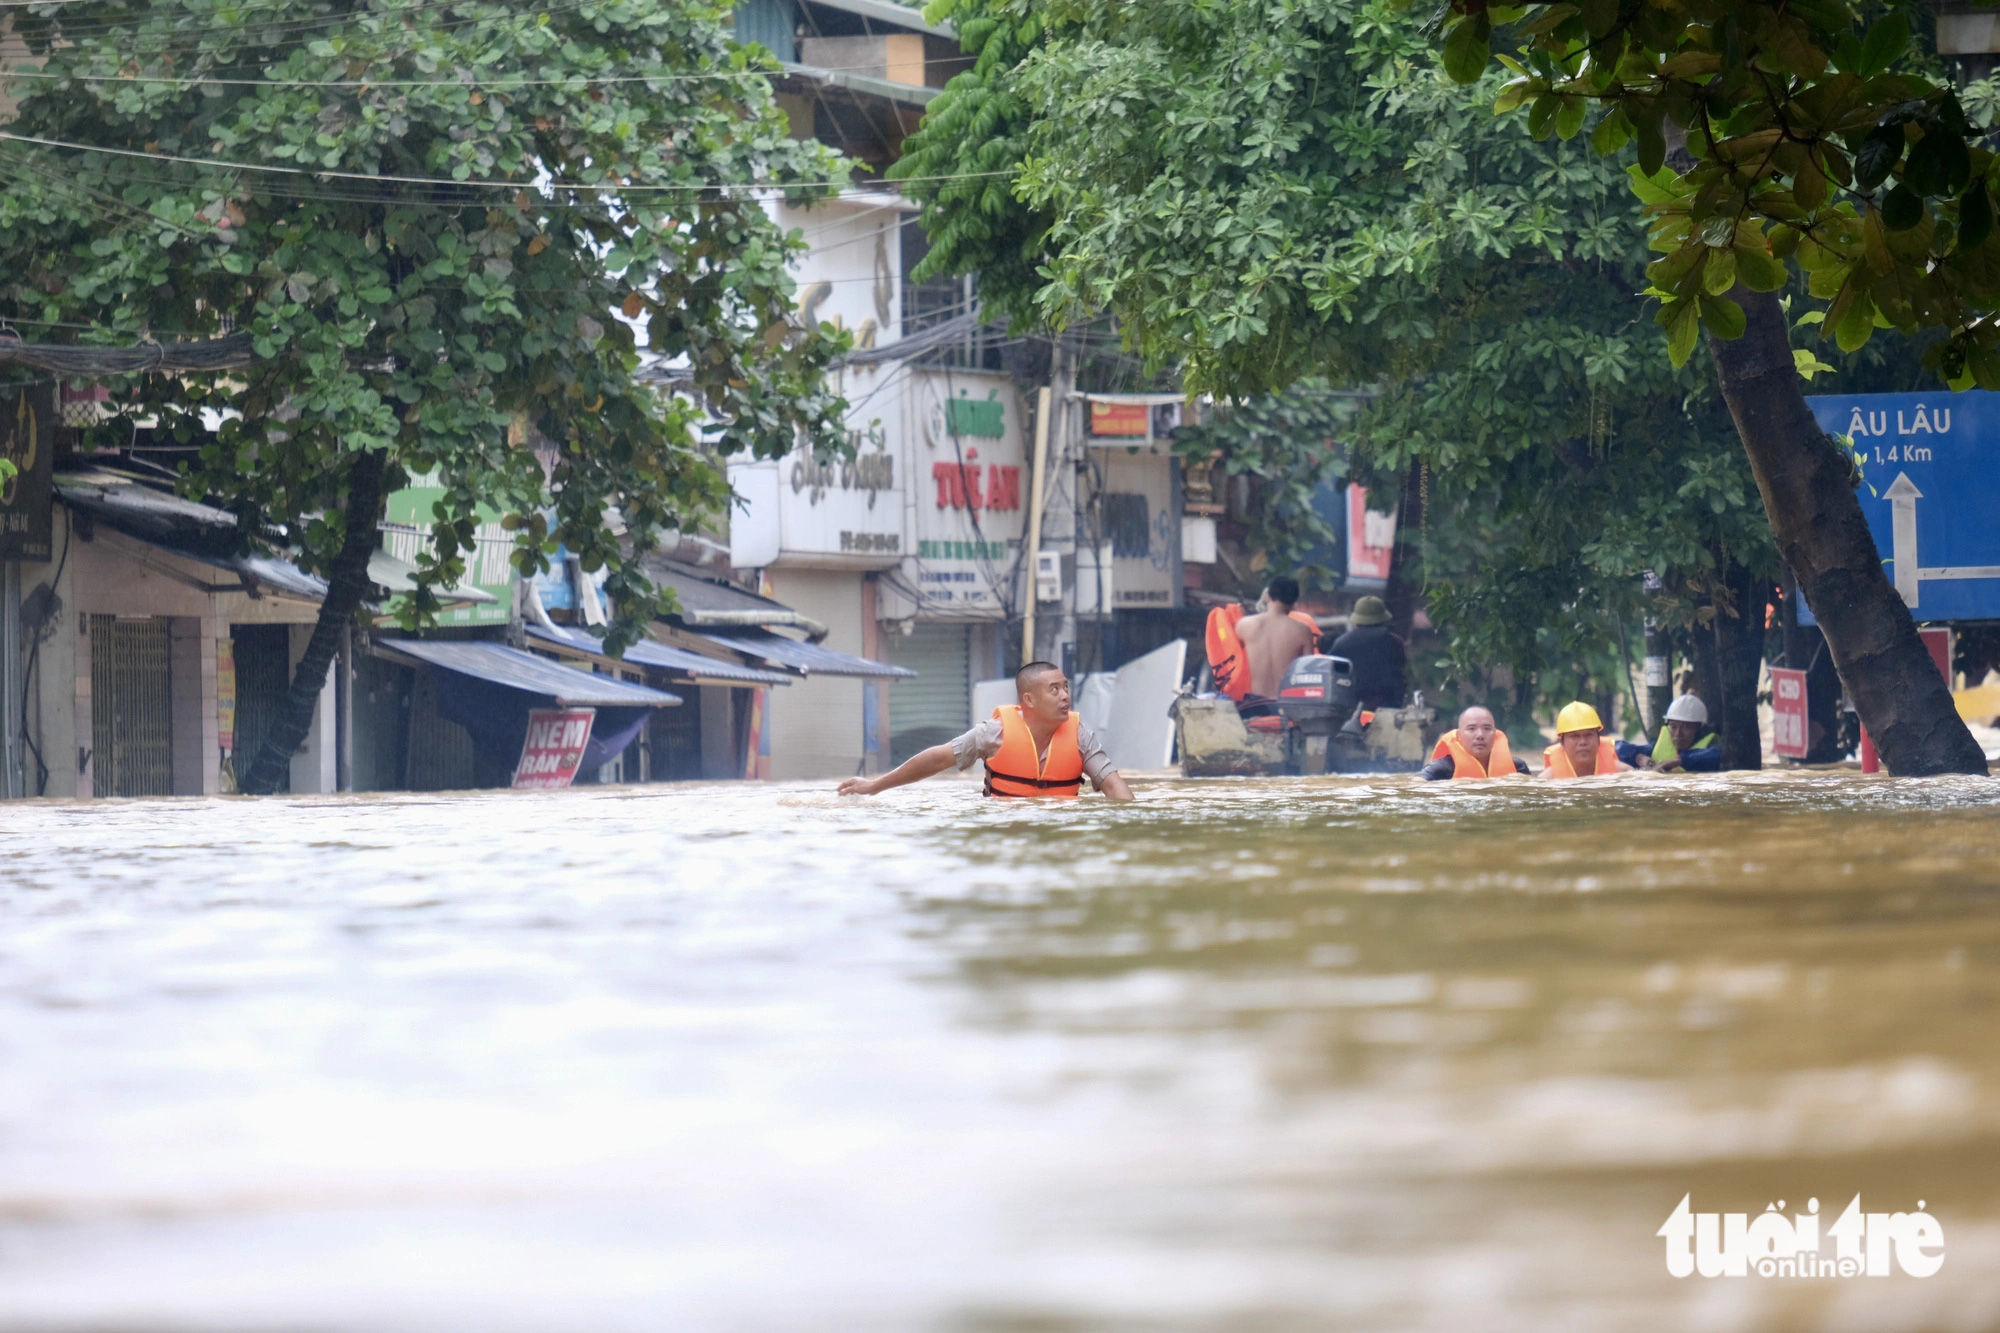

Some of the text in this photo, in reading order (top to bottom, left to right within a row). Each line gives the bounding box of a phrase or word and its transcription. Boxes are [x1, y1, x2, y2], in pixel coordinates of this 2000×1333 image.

[1847, 403, 1951, 436] ÂU LÂU
[1904, 444, 1932, 462] Km
[529, 720, 587, 749] NEM
[521, 749, 561, 774] RÁN
